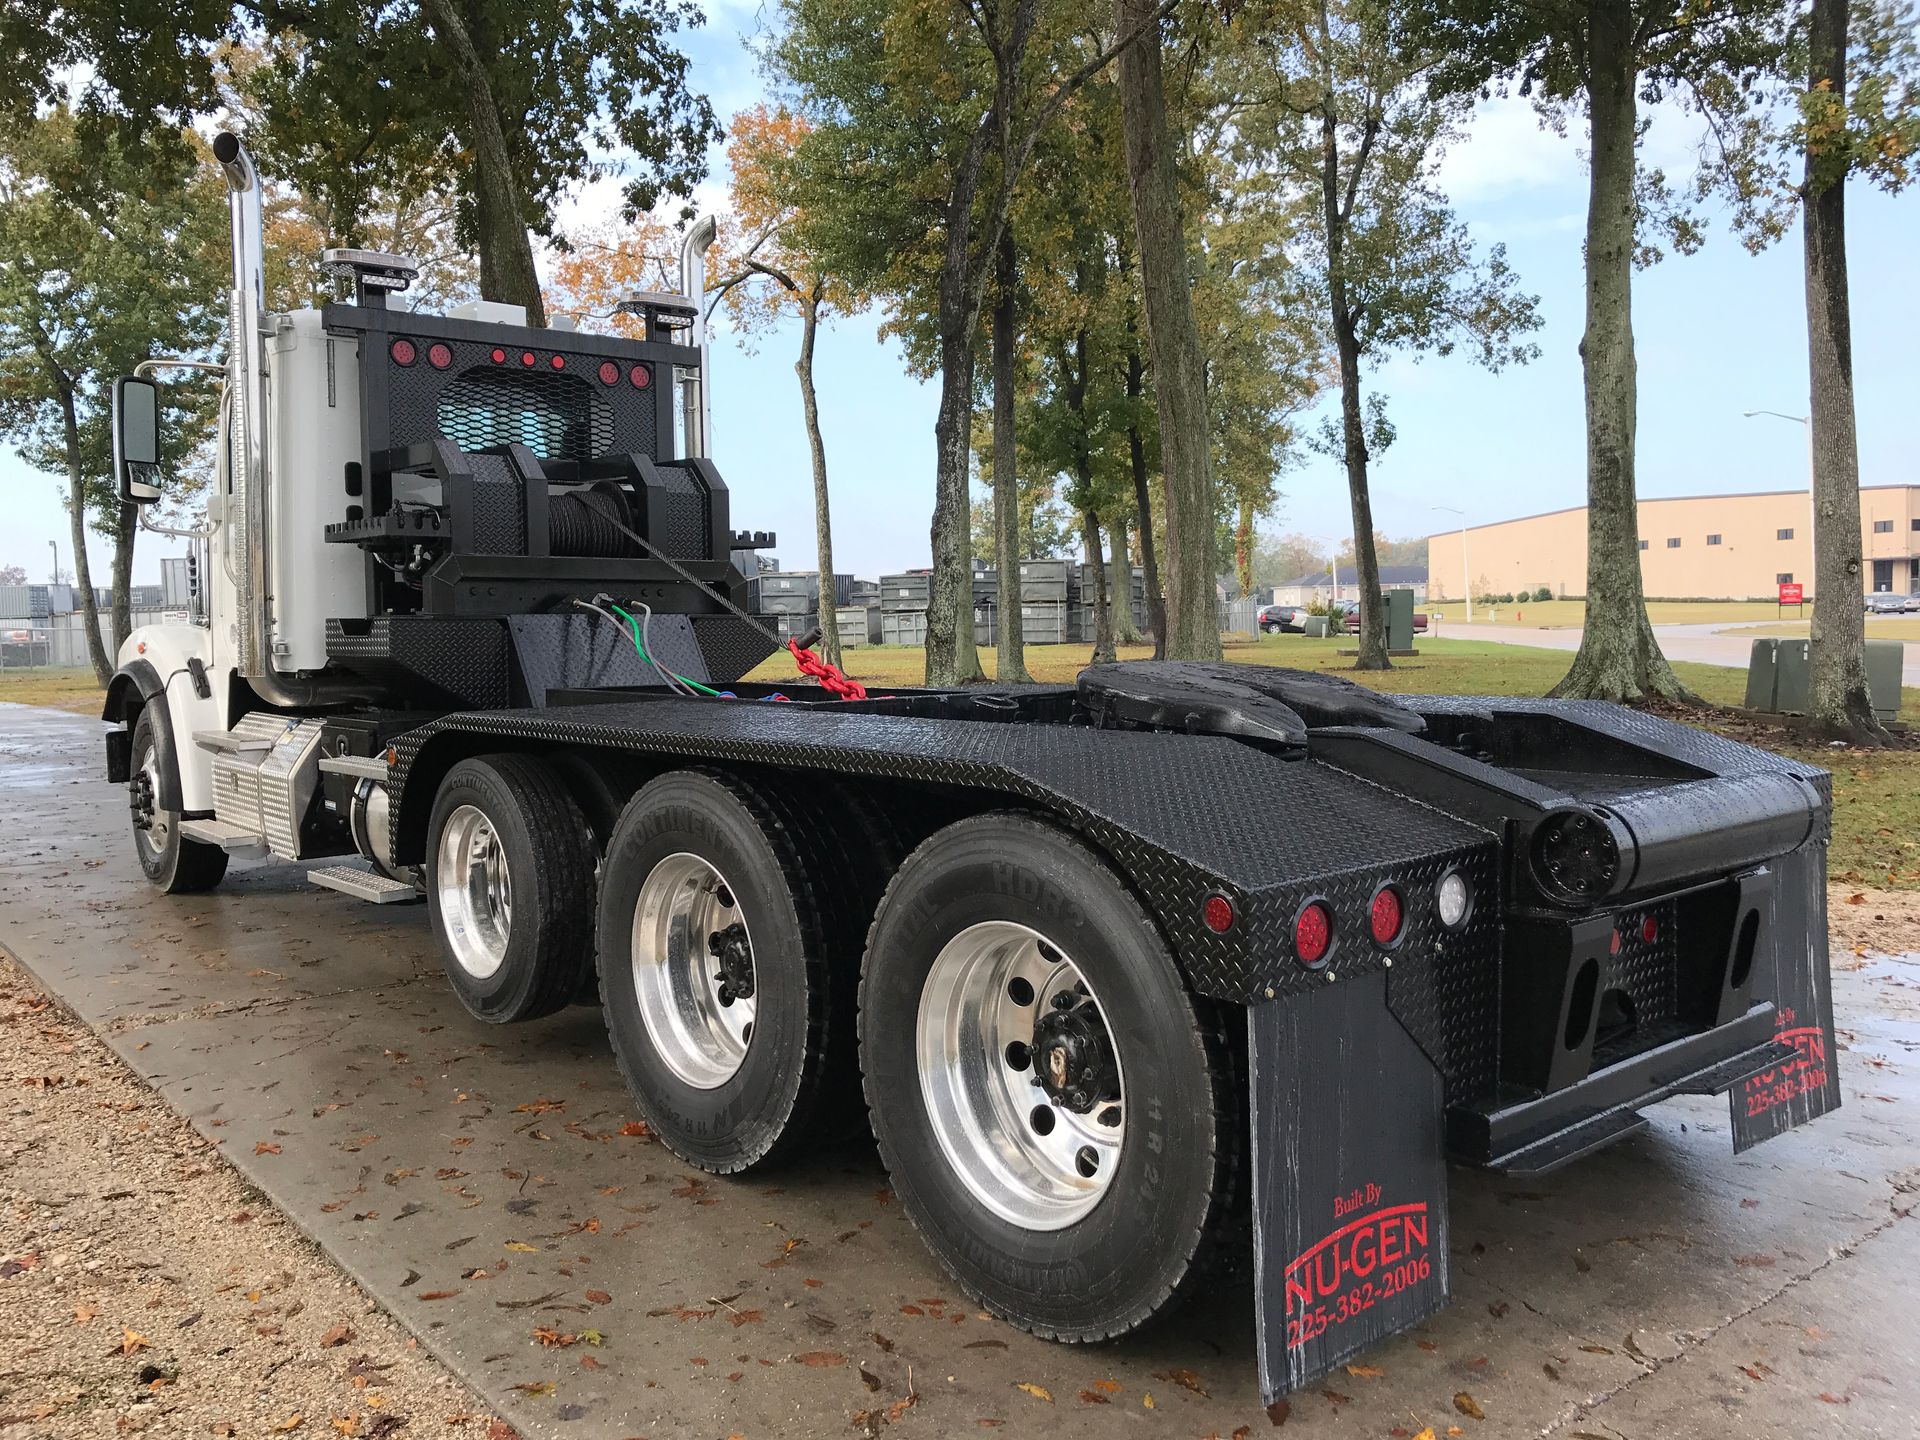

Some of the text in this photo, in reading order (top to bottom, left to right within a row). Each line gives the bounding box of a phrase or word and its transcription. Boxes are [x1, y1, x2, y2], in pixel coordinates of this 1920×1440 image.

[1333, 1183, 1382, 1218] Built By
[1285, 1216, 1428, 1315] NU-GEN
[1287, 1253, 1430, 1349] 225-382-2006
